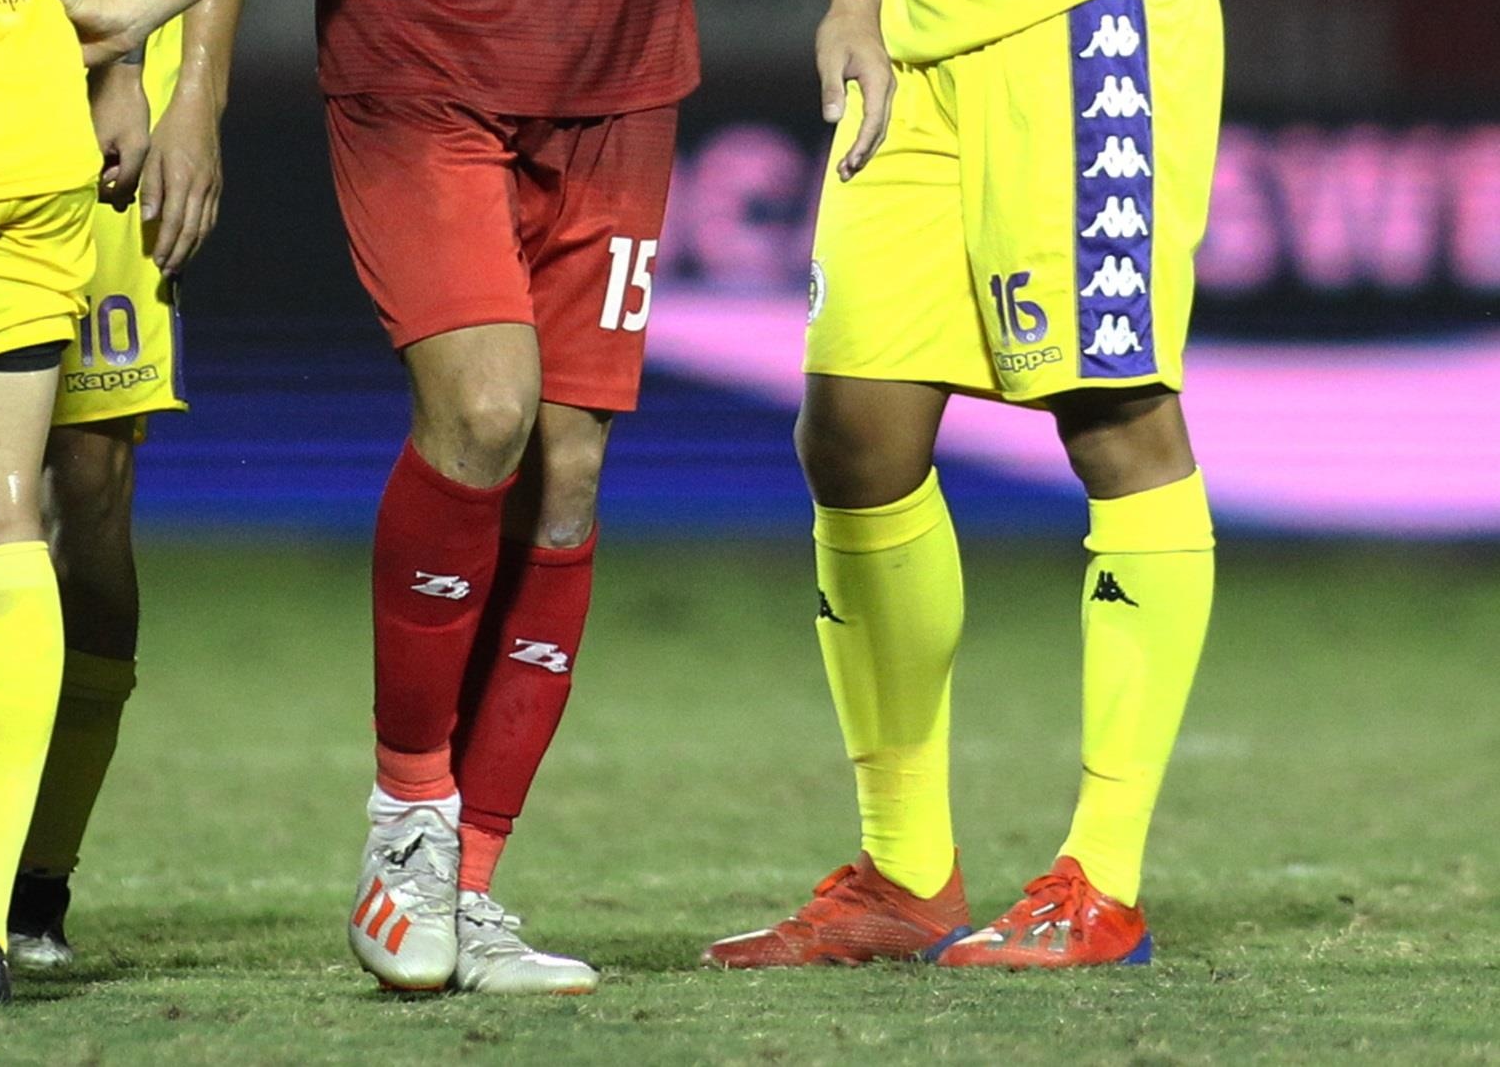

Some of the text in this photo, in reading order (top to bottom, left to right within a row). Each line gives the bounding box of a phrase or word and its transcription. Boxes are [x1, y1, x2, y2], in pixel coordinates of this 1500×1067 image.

[599, 236, 658, 332] 15
[989, 271, 1048, 347] 16
[79, 294, 140, 368] 10
[65, 365, 158, 393] Kappa
